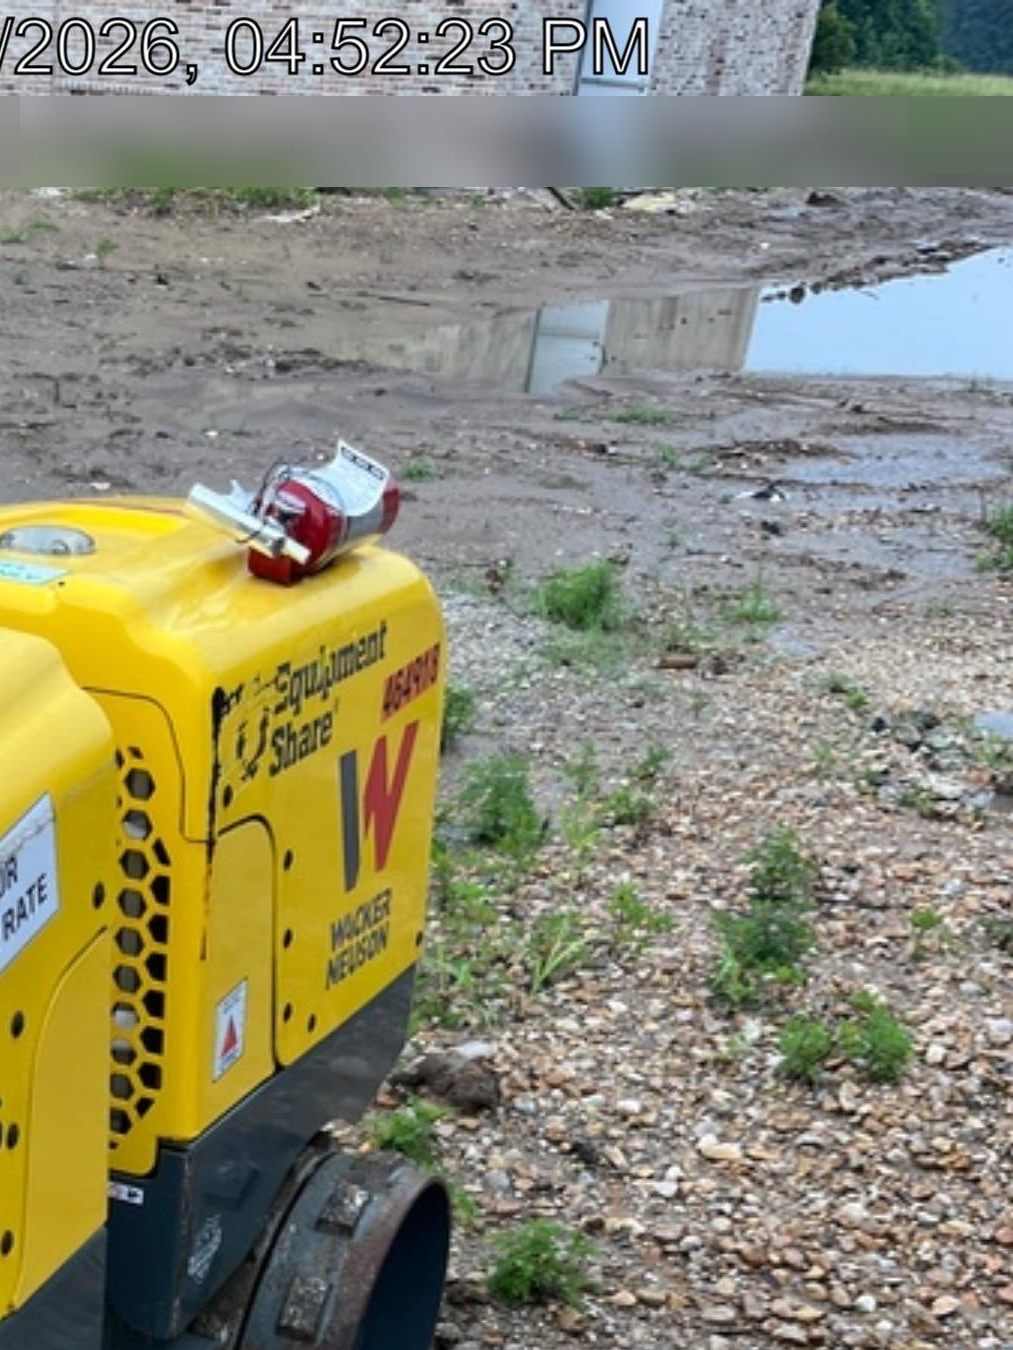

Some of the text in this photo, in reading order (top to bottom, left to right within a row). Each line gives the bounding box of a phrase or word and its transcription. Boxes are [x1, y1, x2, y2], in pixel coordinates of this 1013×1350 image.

[269, 710, 333, 778] Share
[1, 871, 48, 942] RATE
[331, 888, 392, 953] WACKER
[325, 919, 390, 991] NEUSON
